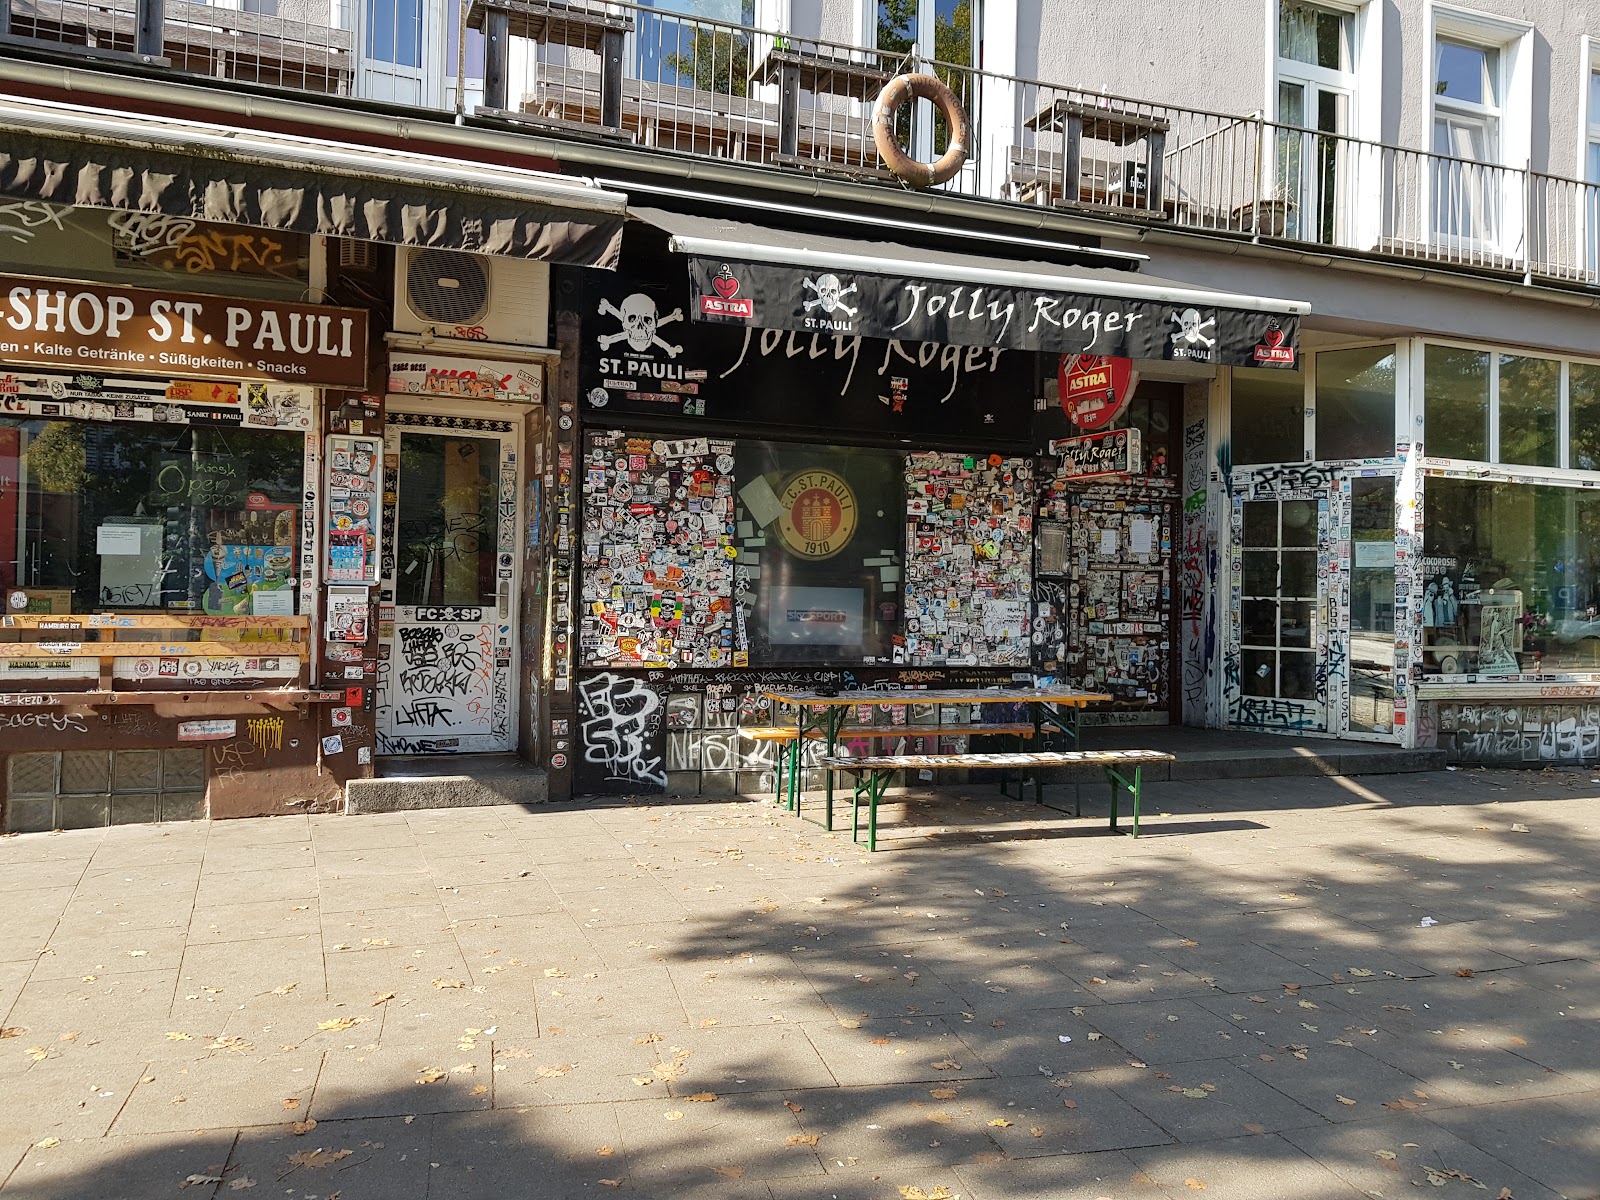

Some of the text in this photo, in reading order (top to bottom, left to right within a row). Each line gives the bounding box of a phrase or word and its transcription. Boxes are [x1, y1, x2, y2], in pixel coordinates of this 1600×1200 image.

[704, 299, 749, 314] ASTRA
[804, 317, 852, 331] ST. PAULI
[891, 285, 1143, 351] Jolly Roger
[147, 300, 213, 345] ST.
[225, 306, 353, 358] PAULI
[34, 342, 72, 357] Kalte
[77, 345, 145, 363] Getränke
[158, 351, 243, 370] Süßigkeiten
[256, 359, 307, 375] Snacks
[1173, 347, 1212, 360] ST. PAULI
[1256, 348, 1291, 360] ASTRA
[598, 357, 683, 380] ST. PAULI
[1069, 372, 1107, 391] ASTRA
[1092, 446, 1125, 461] Roger
[820, 475, 853, 510] PAULI
[804, 540, 830, 554] 1910
[1422, 557, 1457, 567] COCOROSIE
[29, 599, 50, 607] Aloe
[416, 608, 481, 620] FC SP
[810, 611, 847, 621] SPORT
[1103, 623, 1143, 634] ULT RAS
[160, 659, 178, 667] FCK
[159, 667, 178, 675] AFD
